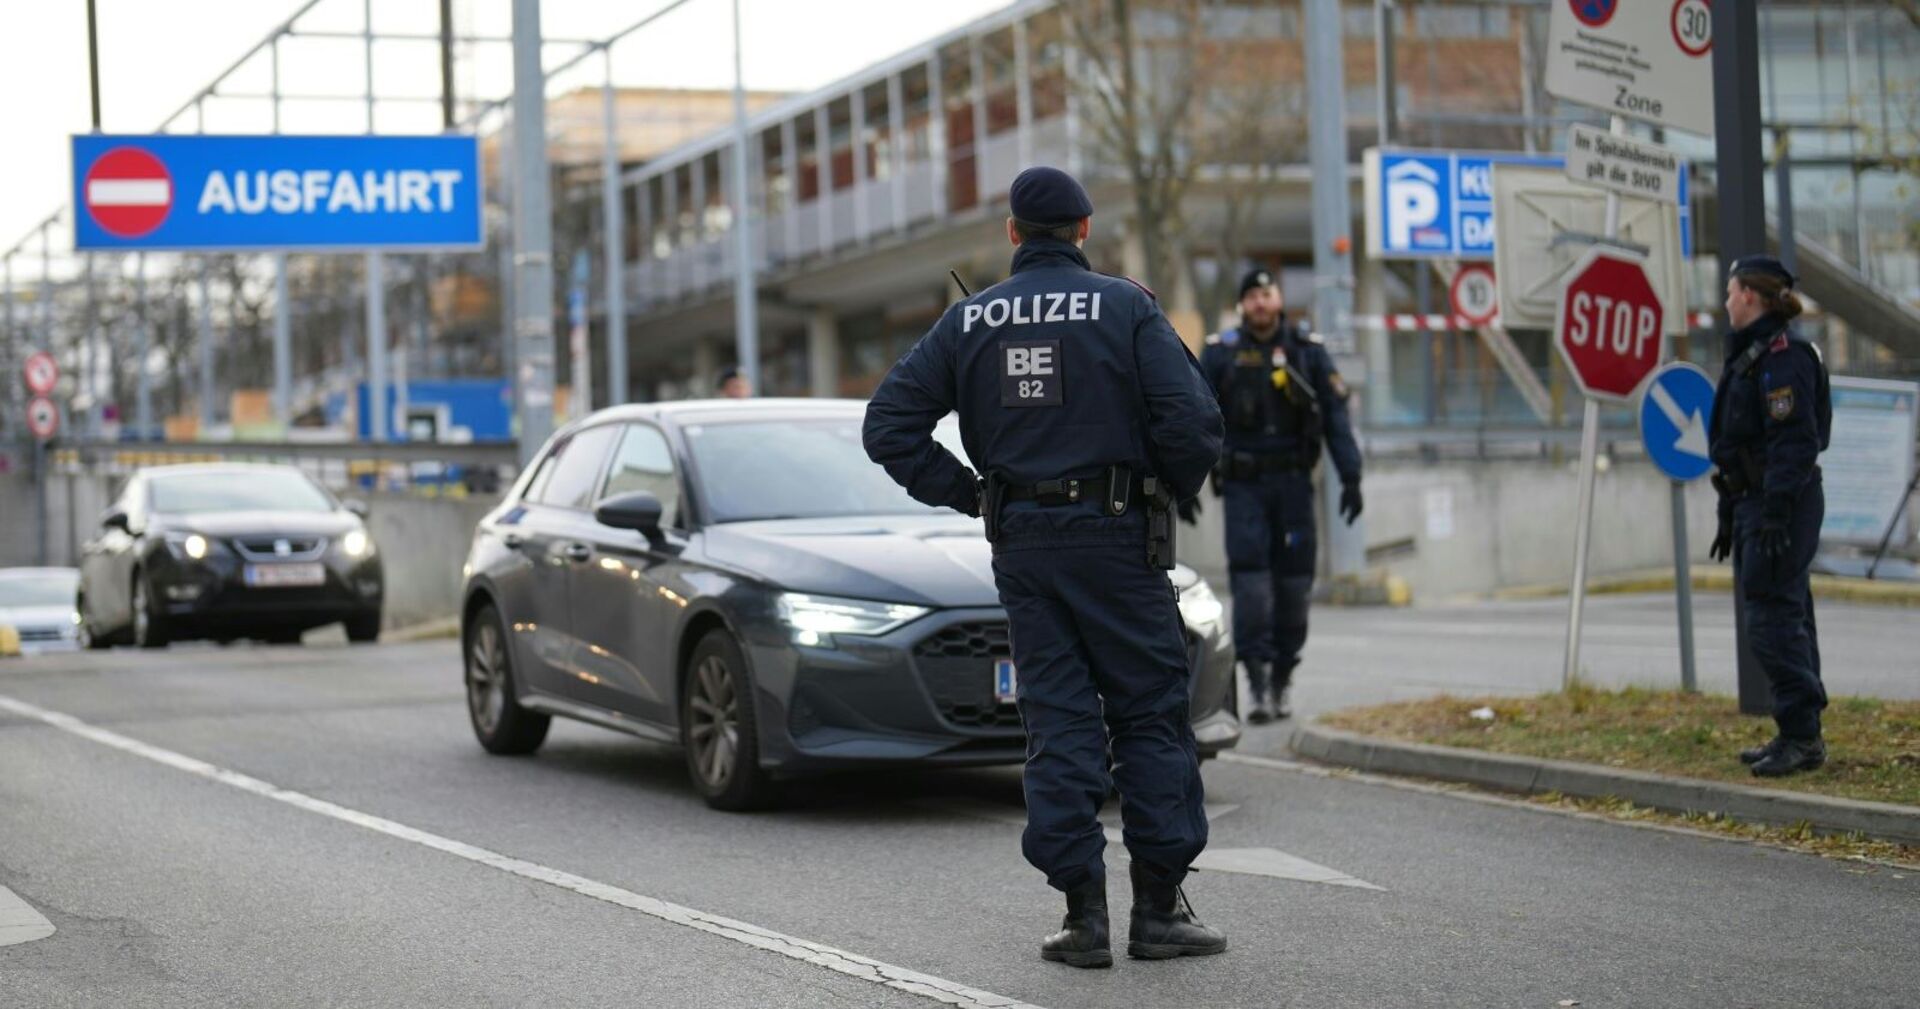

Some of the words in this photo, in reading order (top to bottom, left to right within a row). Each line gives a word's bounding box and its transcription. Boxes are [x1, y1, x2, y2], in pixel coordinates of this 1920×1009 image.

[1683, 7, 1707, 41] 30
[1615, 84, 1662, 117] Zone
[1576, 129, 1590, 151] Im
[198, 169, 462, 214] AUSFAHRT
[963, 292, 1101, 333] POLIZEI
[1570, 290, 1656, 360] STOP
[1007, 347, 1053, 376] BE
[1019, 380, 1044, 398] 82
